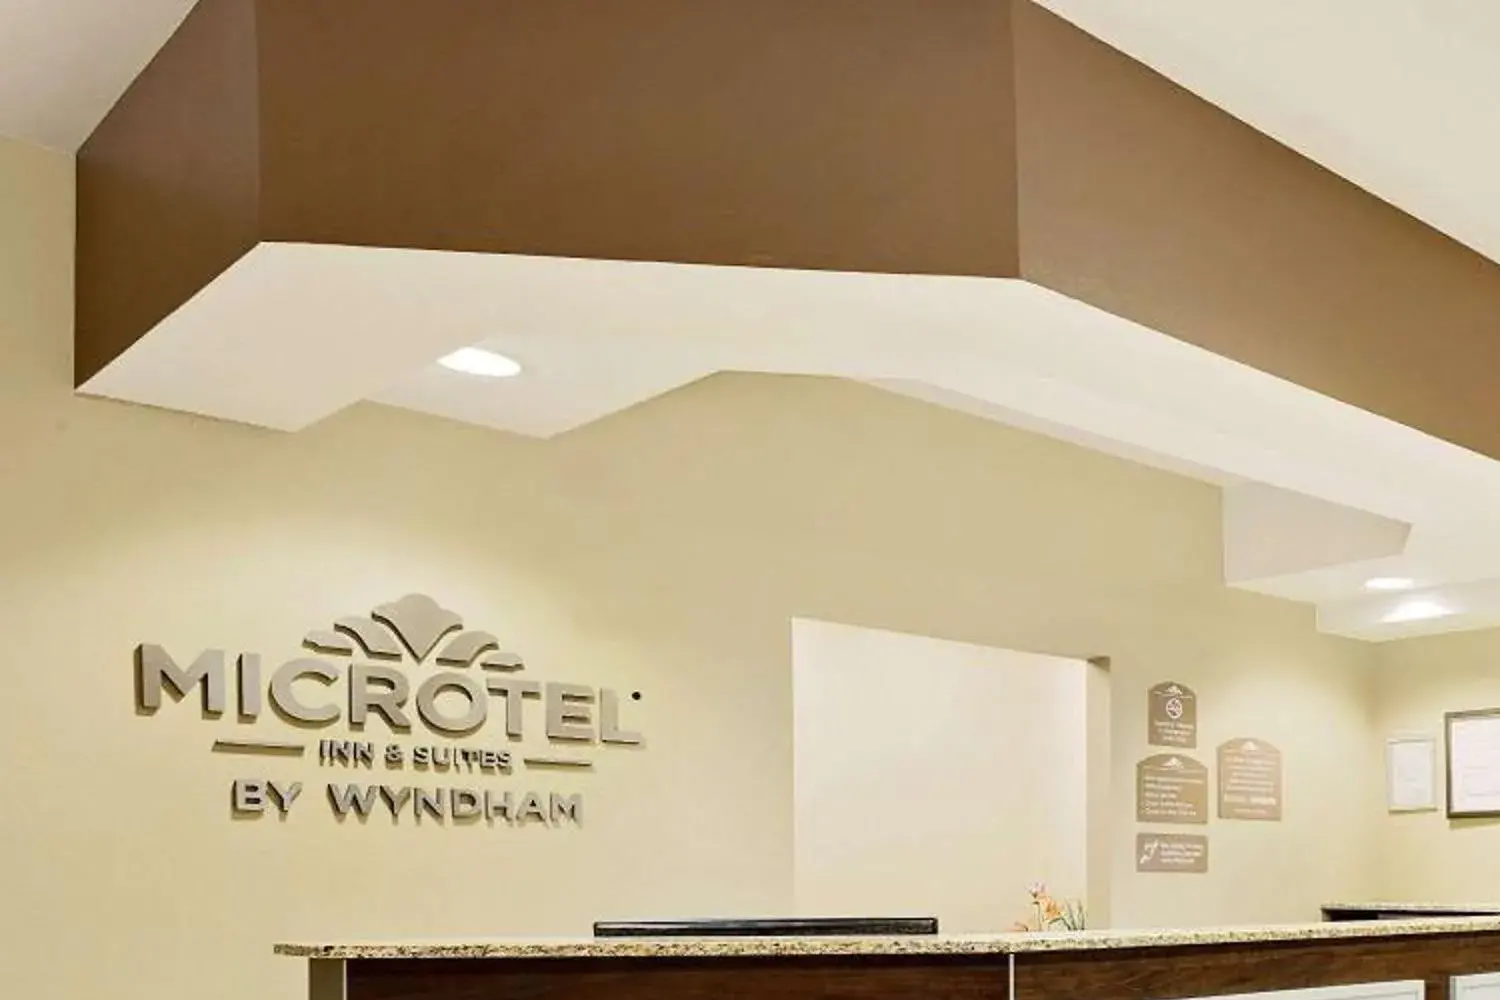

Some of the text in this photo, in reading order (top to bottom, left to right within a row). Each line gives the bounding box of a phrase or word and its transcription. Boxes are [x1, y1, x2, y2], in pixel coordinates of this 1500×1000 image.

[134, 643, 641, 746] MICROTEL
[319, 739, 512, 774] INN & SUITES
[231, 779, 582, 828] BY WYNDHAM
